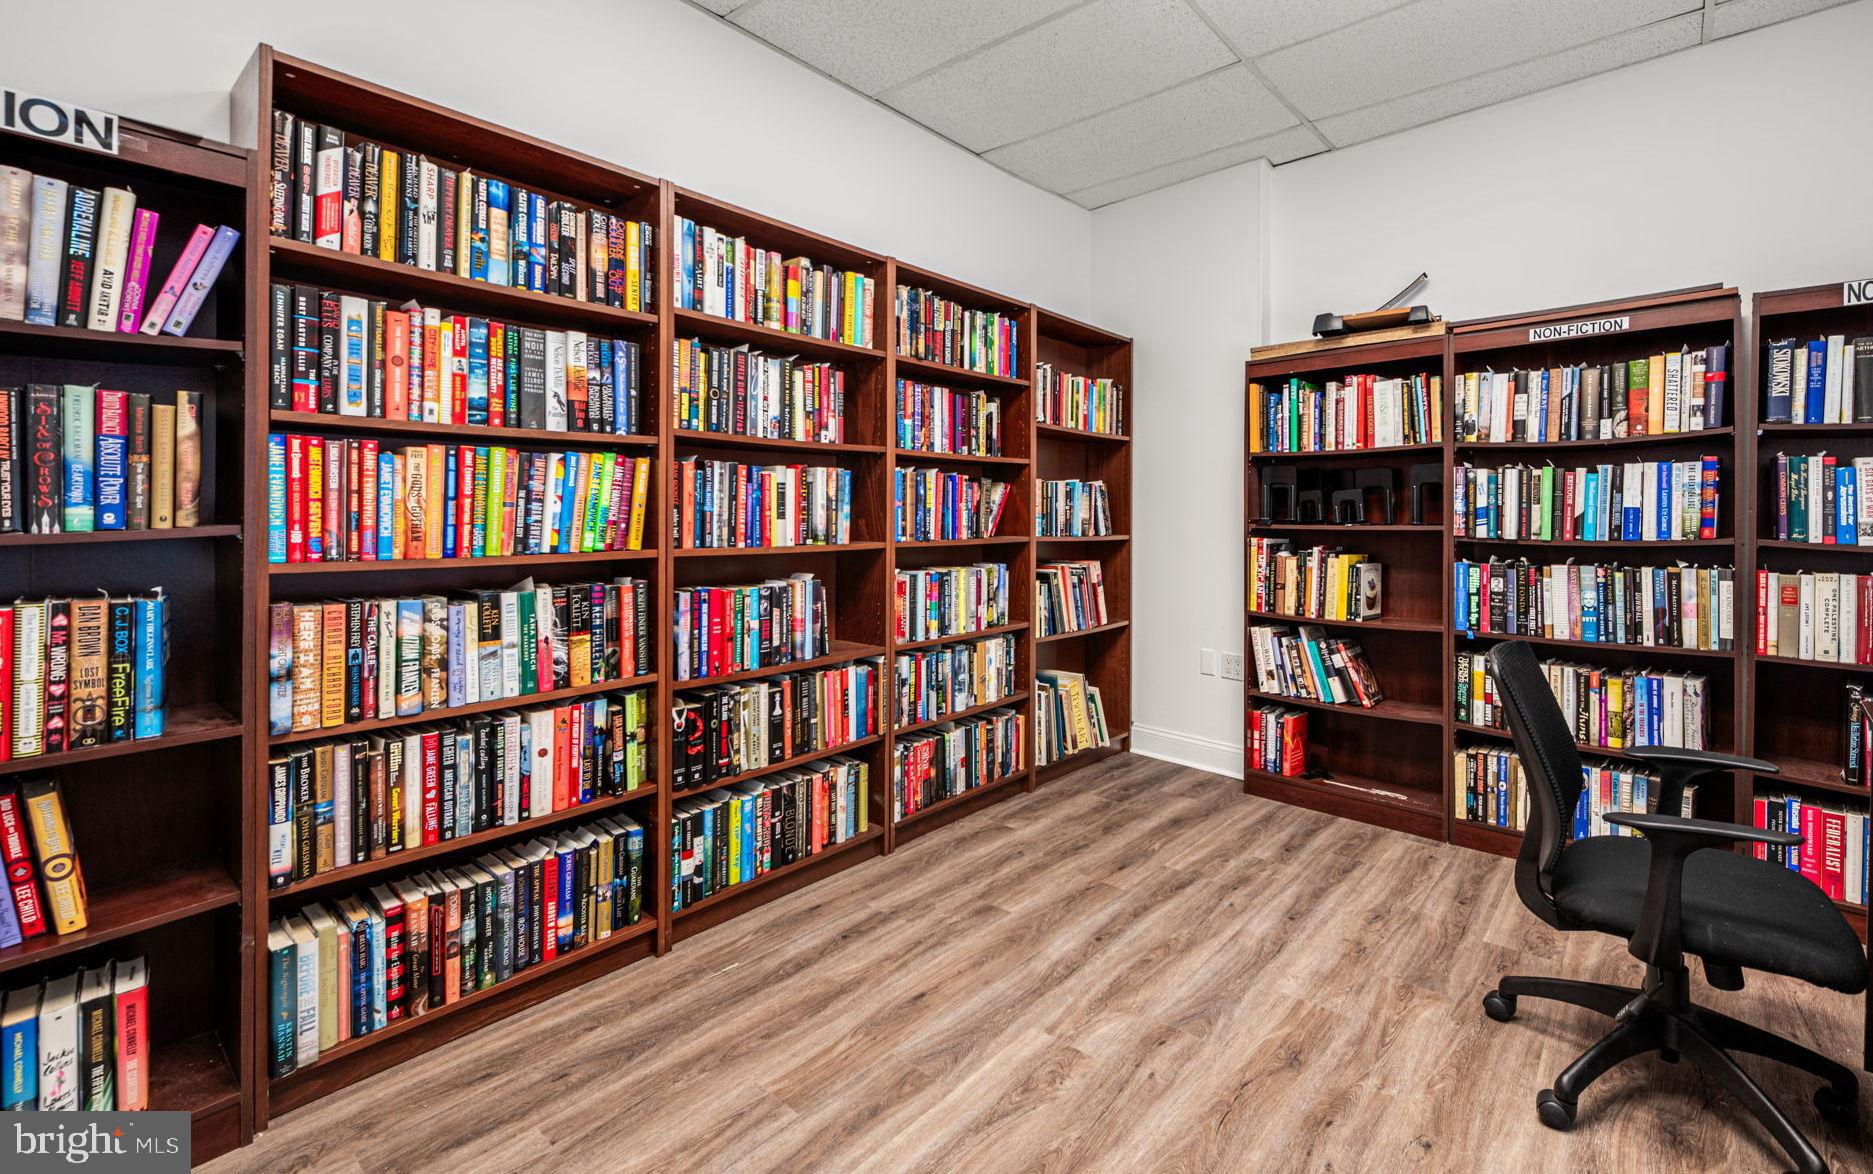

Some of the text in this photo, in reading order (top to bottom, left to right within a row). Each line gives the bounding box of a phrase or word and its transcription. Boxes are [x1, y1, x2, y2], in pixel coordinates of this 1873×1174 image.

[4, 91, 113, 151] ION
[273, 133, 290, 173] DEAVER
[272, 181, 287, 211] SLEEPING
[405, 162, 413, 198] DAWKINS
[426, 166, 435, 200] SHARP
[478, 181, 488, 230] CLIVE CUSSLER
[561, 209, 570, 237] COULTER
[67, 190, 96, 312] ADRENALINE JEFF ABBOTT
[561, 262, 570, 285] SECOND
[631, 279, 639, 306] SENTRY
[275, 289, 286, 351] JENNIFER EGAN
[298, 296, 307, 372] BRET EASTON ELLIS
[321, 299, 332, 329] ELLIS
[1533, 319, 1623, 340] NON-FICTION
[428, 328, 437, 369] CITY FIRE
[507, 330, 515, 355] ELSTON
[572, 339, 586, 363] Nelson
[586, 341, 596, 369] DEKKER
[273, 364, 281, 385] BEACH
[321, 334, 333, 399] COMPANY LIARS
[424, 369, 434, 398] ELLIS
[508, 357, 517, 413] FIRST LIE WINS
[1772, 348, 1791, 397] STOKOWSKI
[308, 368, 316, 409] THE SHARDS
[1665, 368, 1679, 412] SHATTERED
[101, 391, 123, 435] DAVID BALDACCI
[736, 400, 746, 433] 11/22/63
[71, 424, 83, 460] BACKMAN
[2, 461, 13, 518] TRUST YOUR EYES
[71, 463, 85, 504] BEARTOWN
[99, 436, 125, 506] ABSOLUTE POWER
[269, 442, 285, 526] JANET EVANOVICH
[410, 472, 423, 498] GODS
[473, 455, 486, 525] JANET EVANOVICH
[379, 461, 393, 537] JANET EVANOVICH
[1779, 471, 1787, 517] COMMON CENTS
[308, 500, 322, 553] SEVEN UP
[410, 505, 423, 542] GOTHAM
[1257, 554, 1265, 594] MEXICAN
[1518, 567, 1527, 613] JANE FONDA
[349, 603, 362, 647] STEPHEN FREY
[482, 602, 492, 634] FOLLETT
[490, 609, 499, 626] KEN
[1635, 592, 1643, 623] DOWNFALL
[77, 605, 102, 658] DAN BROWN
[115, 631, 129, 654] BOX
[145, 603, 155, 671] MARY HIGGINS CLARK
[366, 616, 377, 665] THE CALLER
[637, 588, 647, 670] JOSEPH FINDER VANISHED
[49, 630, 68, 682] Mr. WRONG
[299, 611, 315, 689] HERE AM
[429, 601, 441, 708] CROSSROADS FRANZEN
[529, 638, 537, 671] FRENCH
[1263, 648, 1271, 667] WINE
[79, 666, 100, 678] LOST
[326, 655, 342, 721] RICHARD FORD
[720, 704, 729, 722] ISLAND
[801, 681, 809, 719] STEVE MARTINI
[389, 741, 403, 772] Griffin
[426, 749, 438, 788] JANE GREEN
[274, 765, 287, 823] JAMES GRIPPANDO
[442, 733, 455, 829] TIM GREEN AMERICAN OUTRAGE
[300, 768, 312, 877] BROKER JOHN GRISHAM
[425, 801, 438, 831] FALLING
[784, 807, 797, 855] BLONDE
[1806, 809, 1814, 857] BOB WOODWARD
[271, 849, 283, 865] KILL
[1825, 817, 1842, 873] FEDERALIST
[15, 884, 37, 924] LEE CHILD
[516, 917, 526, 958] IRON HOUSE
[389, 930, 402, 996] Water for Elephants
[299, 955, 317, 1036] BEFORE FALL
[90, 1009, 105, 1063] MICHAEL CONNELLY
[125, 1003, 138, 1057] MICHAEL CONNELLY
[277, 1023, 286, 1062] HANNAH
